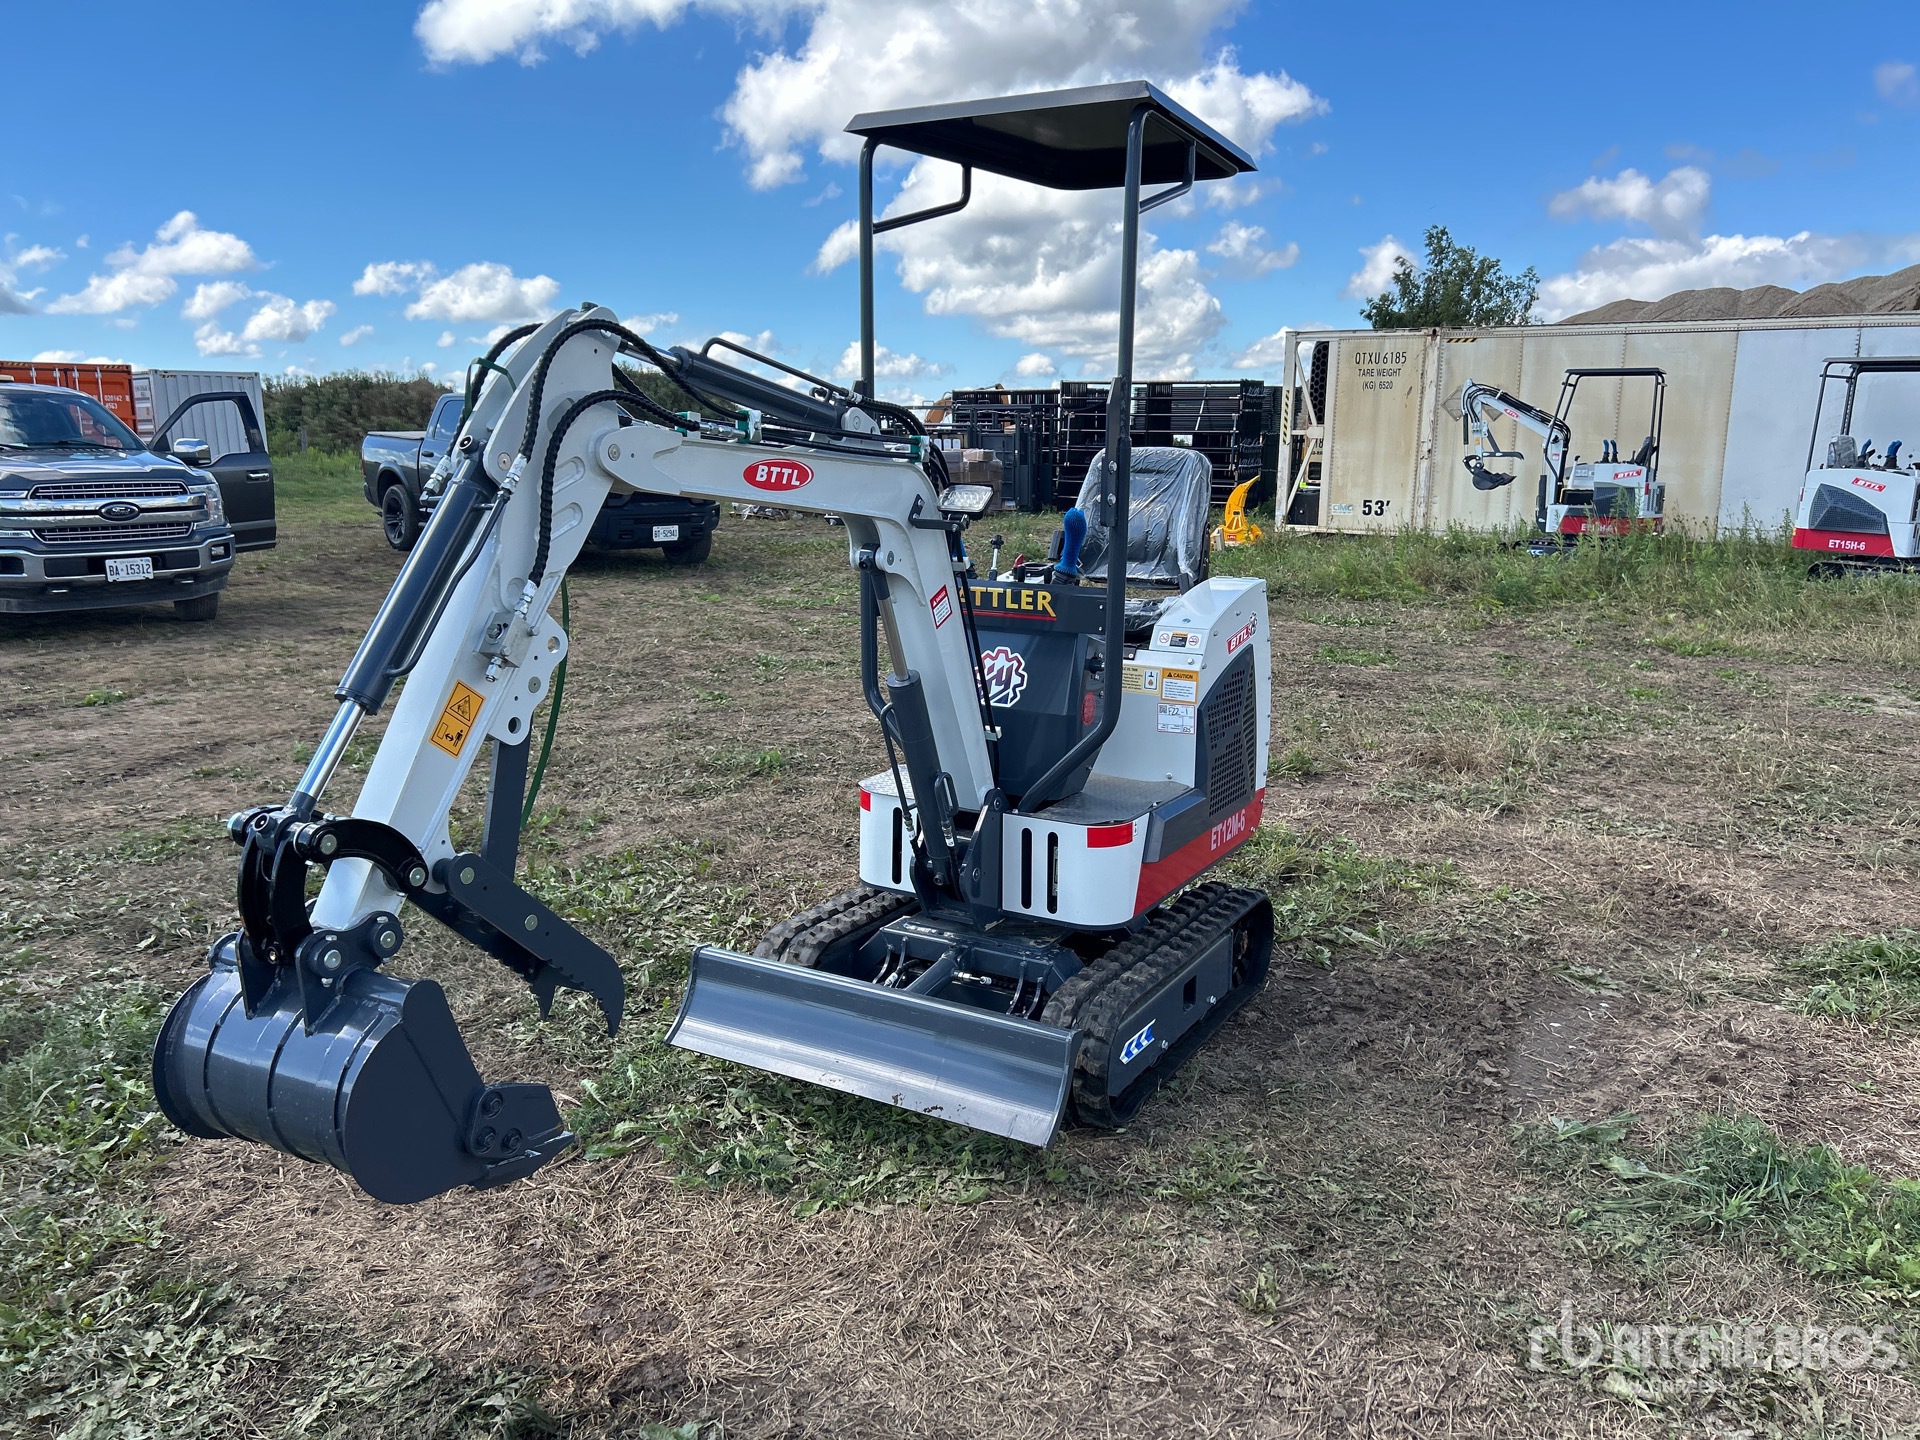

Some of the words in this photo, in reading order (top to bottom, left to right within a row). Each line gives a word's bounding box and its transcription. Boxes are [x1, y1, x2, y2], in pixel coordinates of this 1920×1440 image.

[1382, 351, 1407, 365] 6185
[1358, 368, 1375, 377] TARE
[1376, 367, 1402, 377] WEIGHT
[1362, 380, 1376, 391] (KG)
[1378, 380, 1393, 390] 6520
[756, 464, 801, 486] BTTL
[1857, 479, 1881, 490] BTTL
[1828, 539, 1866, 551] ET15H-6
[108, 565, 120, 576] BA
[125, 563, 152, 575] 15312
[1229, 627, 1249, 651] BTTL
[1173, 672, 1194, 680] CAUTION
[1210, 808, 1246, 851] ET12M-6
